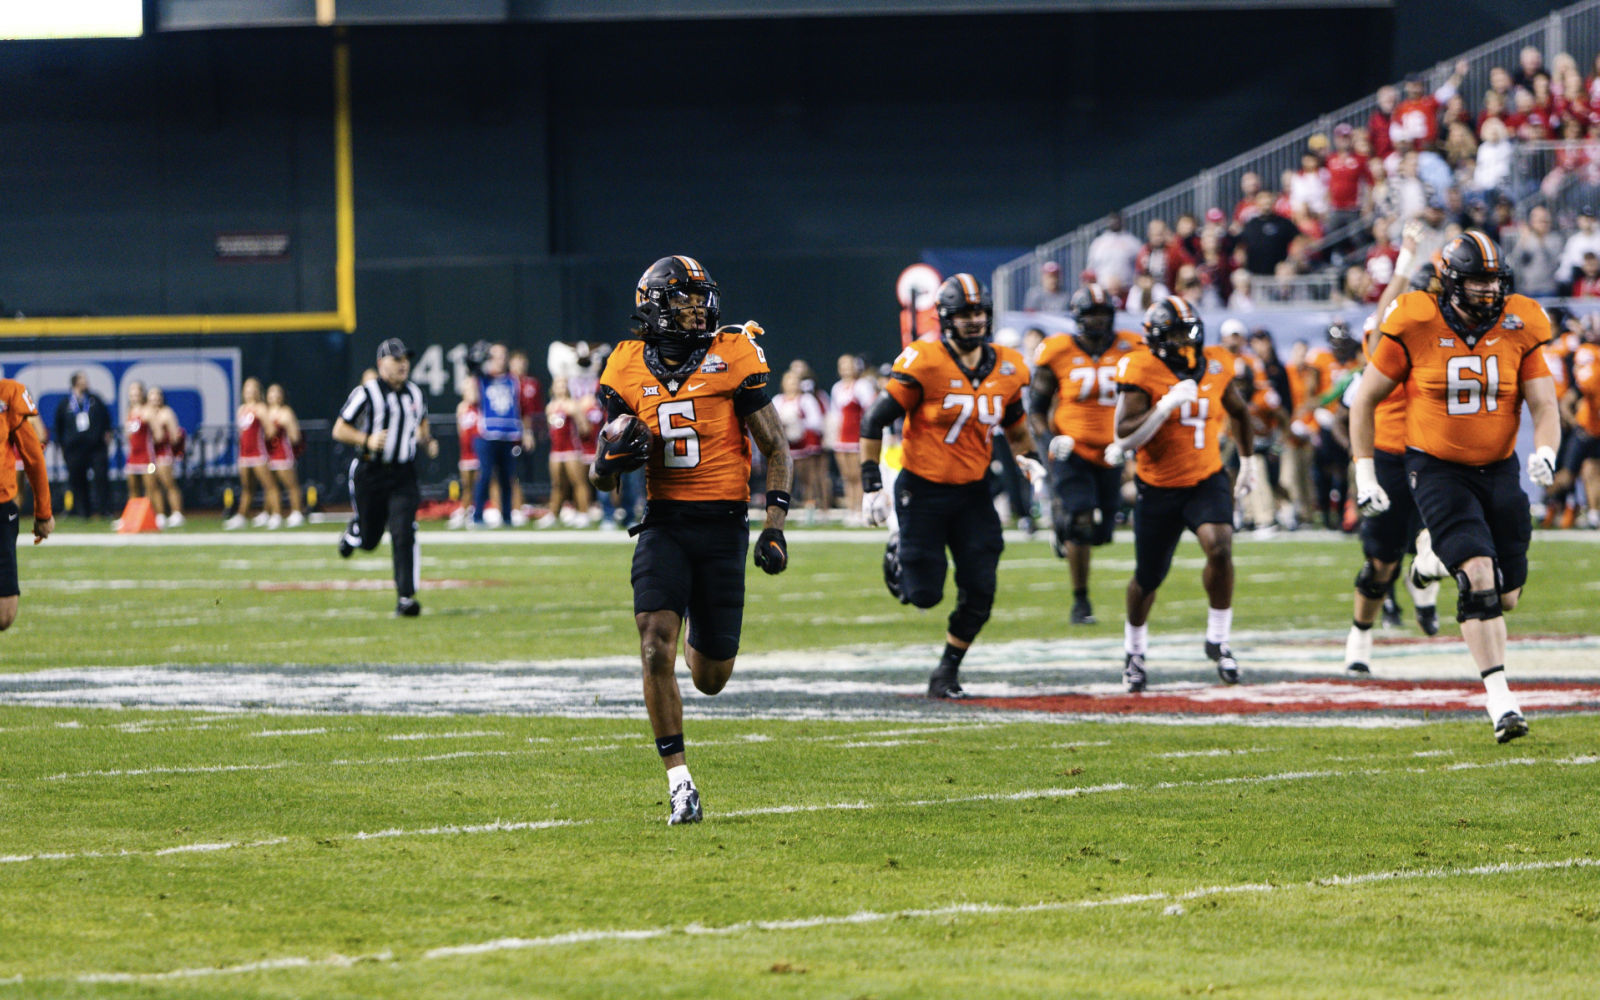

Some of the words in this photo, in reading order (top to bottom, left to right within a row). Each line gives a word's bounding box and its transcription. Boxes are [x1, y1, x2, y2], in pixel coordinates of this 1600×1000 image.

[1069, 366, 1119, 406] 76
[1446, 355, 1500, 416] 61
[656, 398, 702, 469] 6
[943, 393, 1004, 444] 74
[1180, 397, 1210, 449] 4
